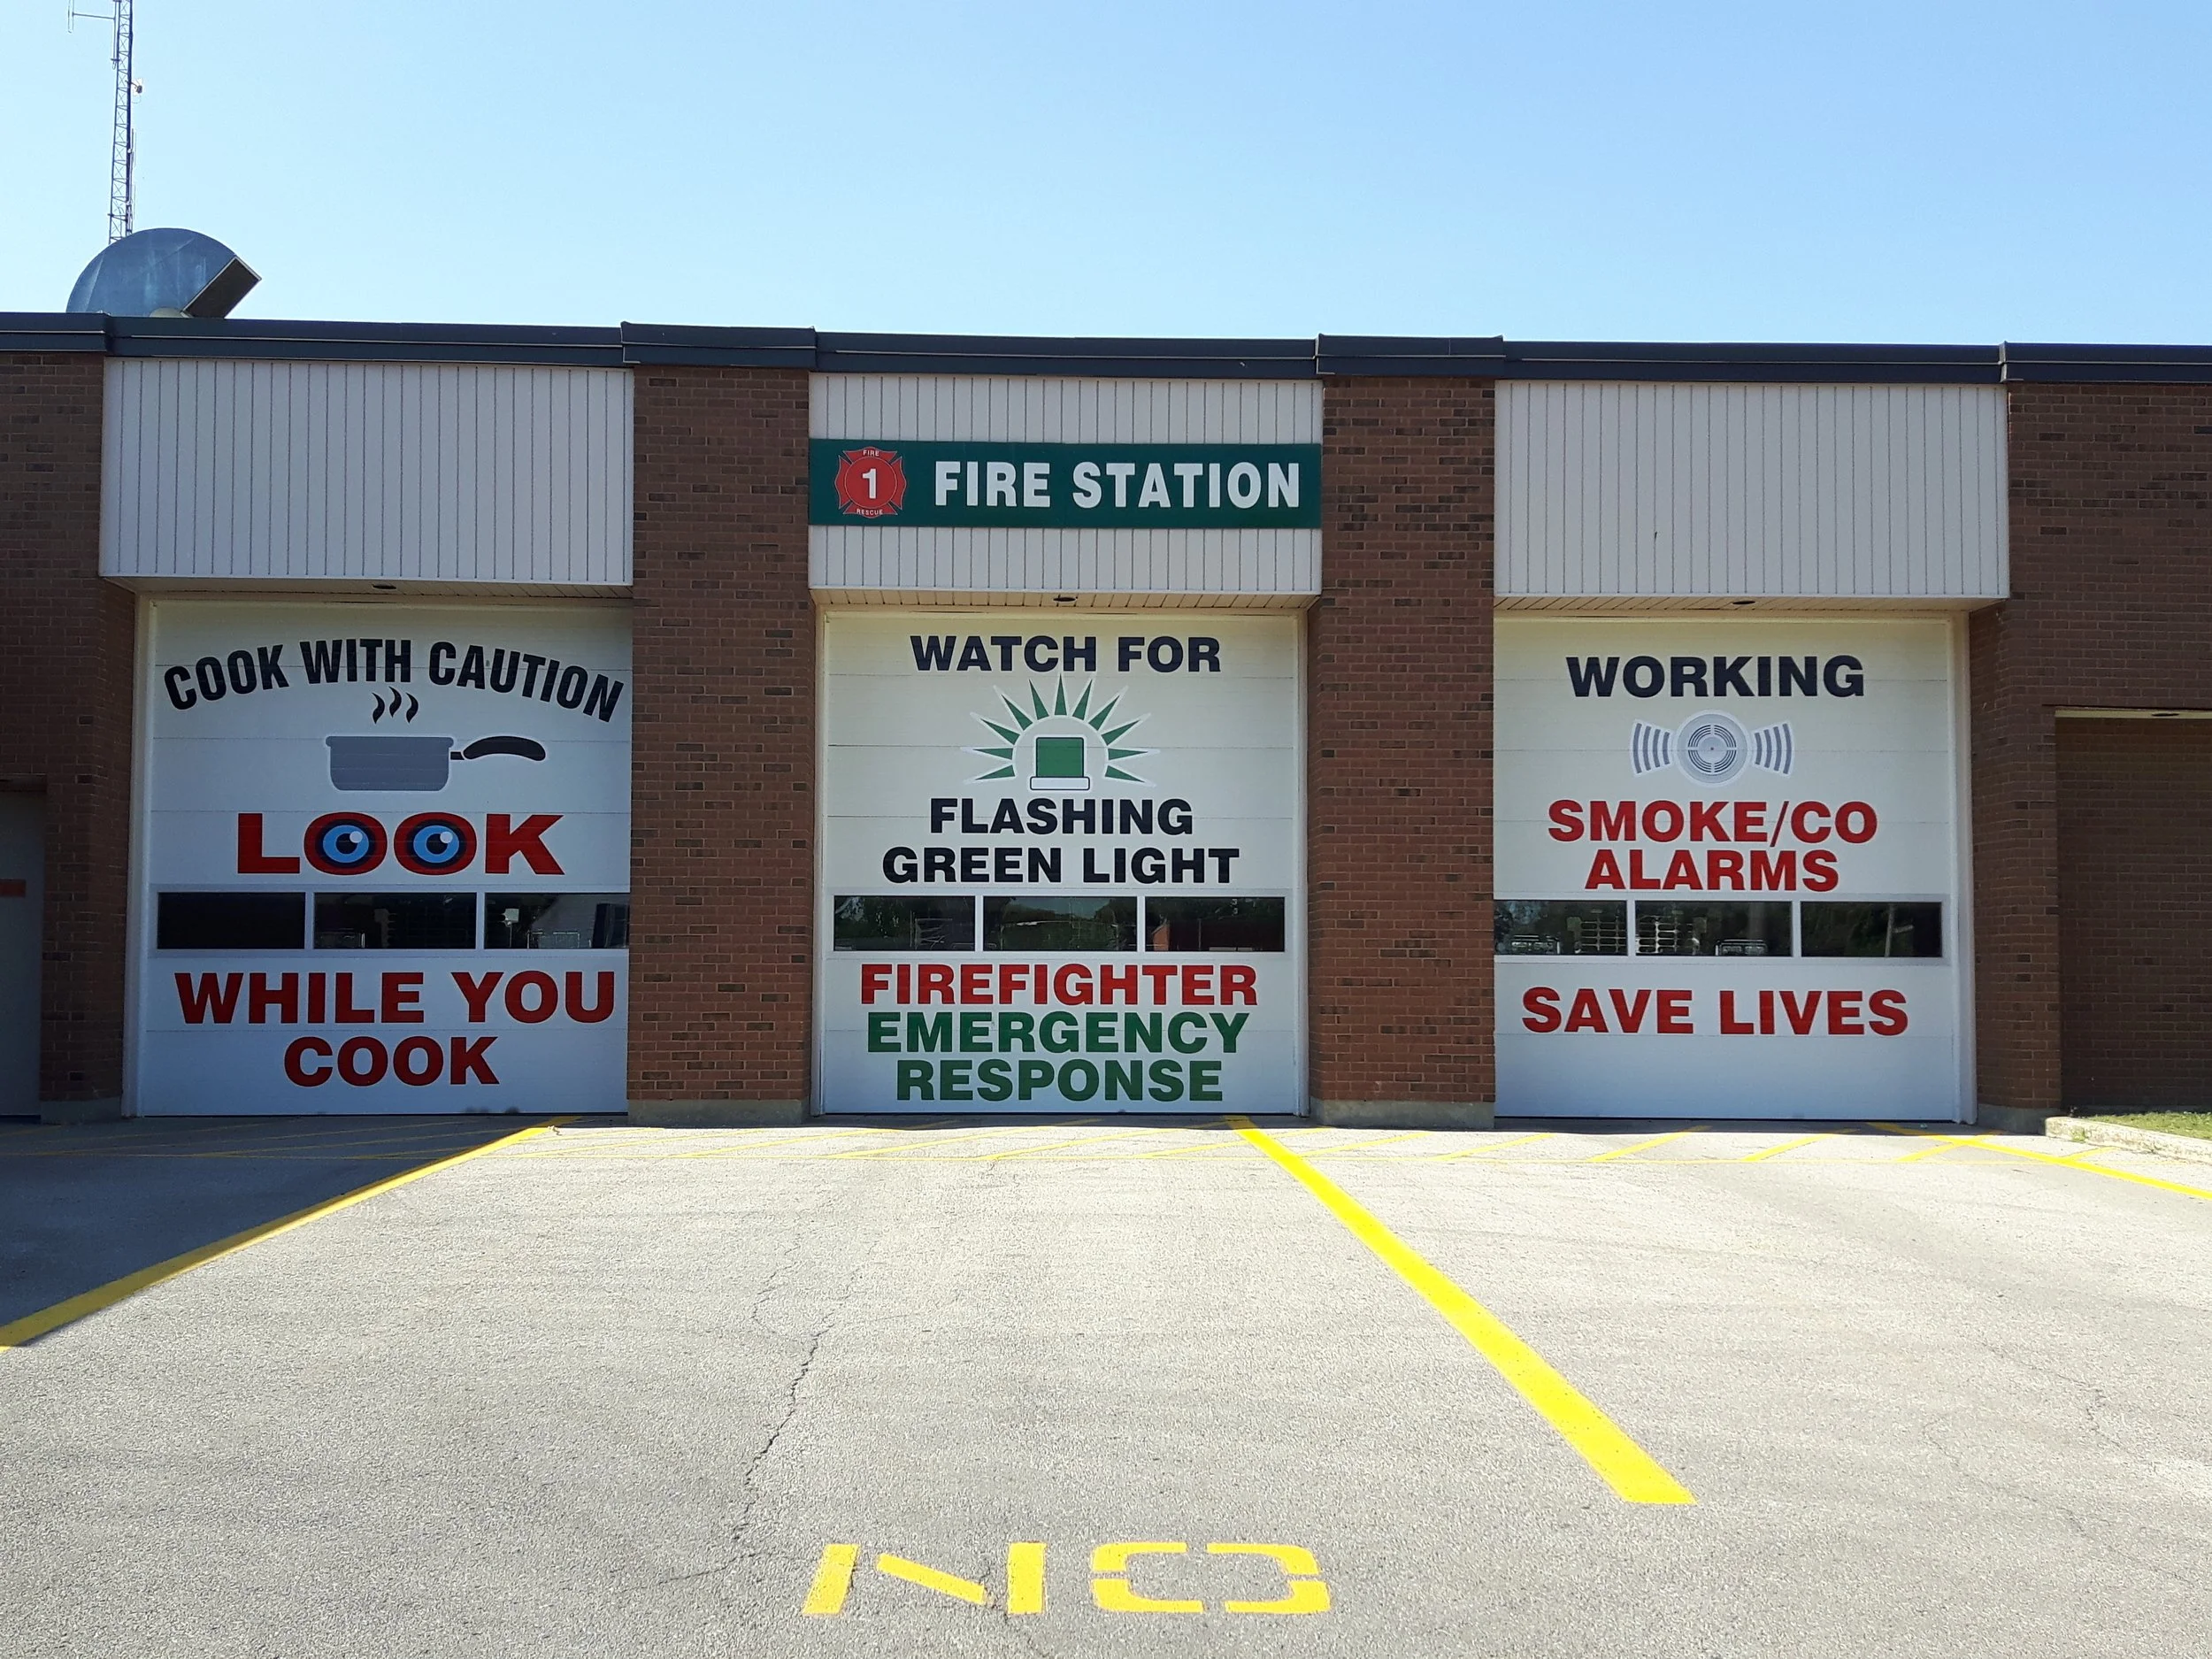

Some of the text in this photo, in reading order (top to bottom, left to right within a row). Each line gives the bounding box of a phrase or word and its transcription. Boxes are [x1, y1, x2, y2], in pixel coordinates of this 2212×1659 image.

[862, 468, 877, 499] 1
[934, 461, 1300, 509] FIRE STATION
[910, 635, 1221, 672] WATCH FOR
[164, 638, 625, 723] COOK WITH CAUTION
[1566, 655, 1864, 697] WORKING
[930, 798, 1193, 835] FLASHING
[1548, 800, 1878, 848] SMOKE/CO
[237, 811, 565, 876] LOOK
[882, 847, 1239, 884] GREEN LIGHT
[1585, 849, 1839, 892] ALARMS
[175, 971, 614, 1024] WHILE YOU
[861, 964, 1257, 1005] FIREFIGHTER
[867, 1011, 1249, 1053] EMERGENCY
[1522, 987, 1909, 1036] SAVE LIVES
[284, 1036, 500, 1087] COOK
[896, 1059, 1223, 1102] RESPONSE
[802, 1541, 1331, 1615] NO
